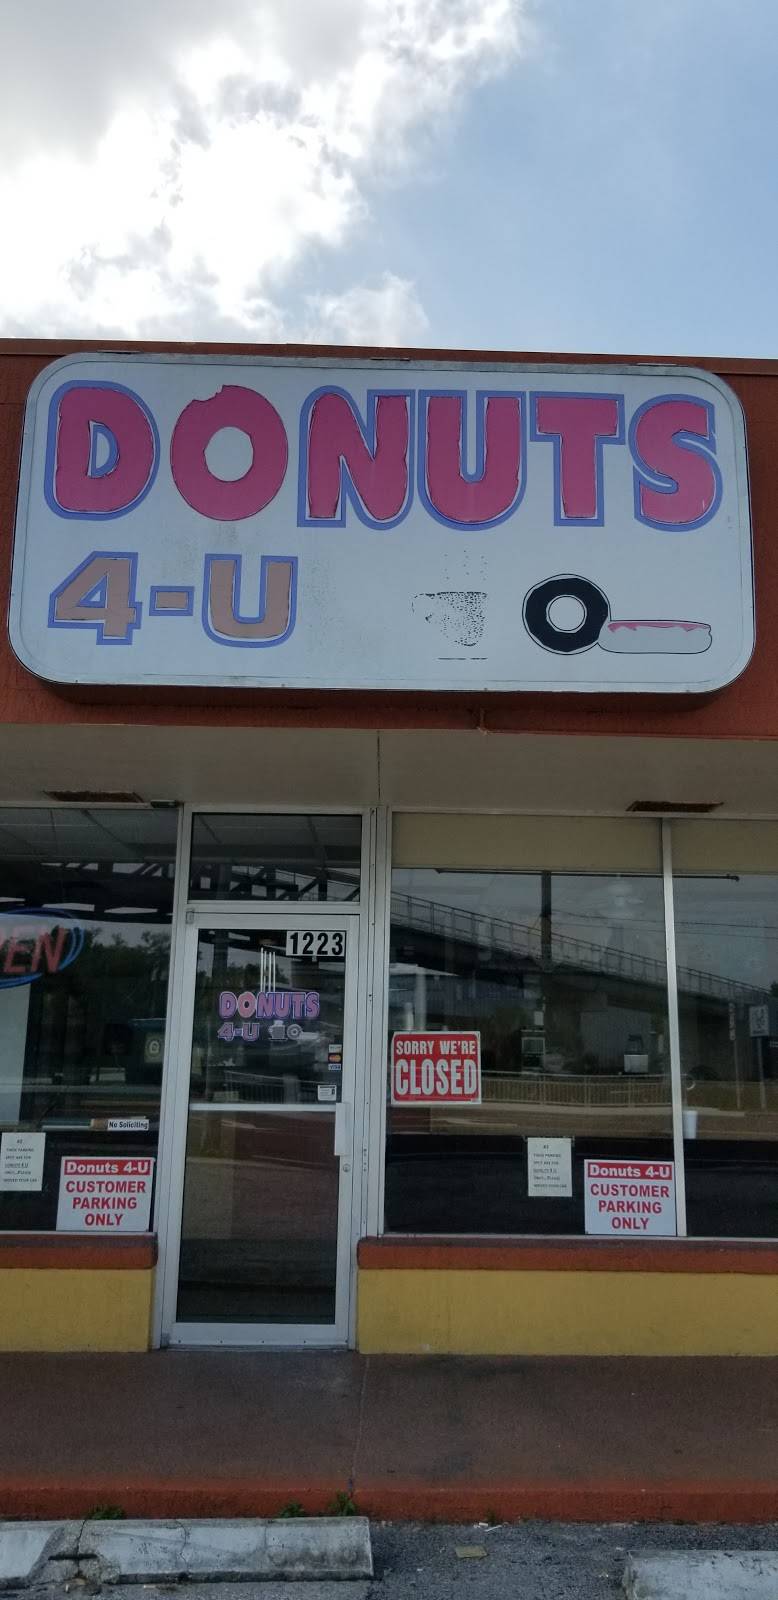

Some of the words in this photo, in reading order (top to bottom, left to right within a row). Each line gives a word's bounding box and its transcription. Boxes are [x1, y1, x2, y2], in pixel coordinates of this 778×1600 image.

[44, 380, 722, 531] DONUTS
[48, 551, 298, 648] 4-U
[290, 932, 343, 955] 1223
[219, 991, 320, 1018] DONUTS
[217, 1022, 260, 1041] 4-U
[396, 1040, 434, 1055] SORRY
[440, 1040, 476, 1055] WE'RE
[396, 1059, 477, 1095] CLOSED
[119, 1120, 148, 1130] Soliciting
[66, 1161, 119, 1173] Donuts
[123, 1161, 148, 1173] 4-U
[589, 1164, 641, 1178] Donuts
[645, 1166, 670, 1178] 4-U
[66, 1181, 146, 1193] CUSTOMER
[590, 1184, 669, 1197] CUSTOMER
[72, 1197, 137, 1209] PARKING
[598, 1200, 662, 1214] PARKING
[84, 1213, 123, 1226] ONLY
[611, 1217, 649, 1230] ONLY
